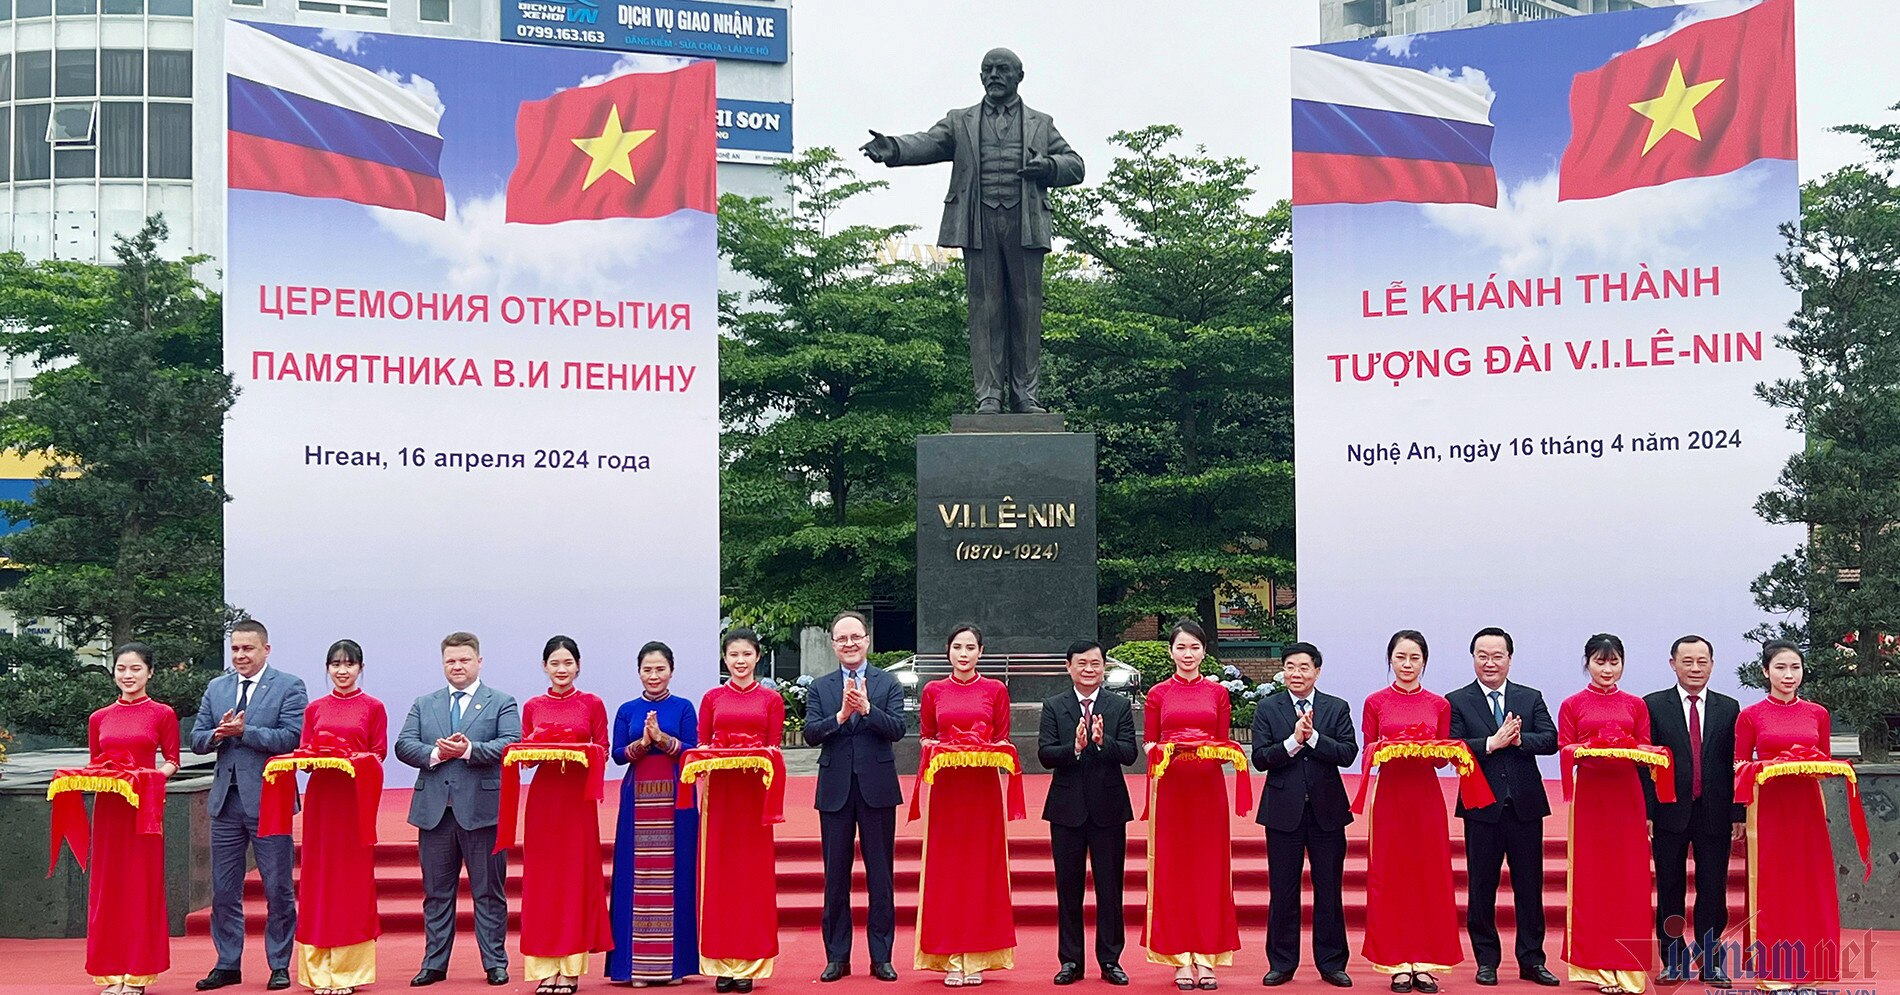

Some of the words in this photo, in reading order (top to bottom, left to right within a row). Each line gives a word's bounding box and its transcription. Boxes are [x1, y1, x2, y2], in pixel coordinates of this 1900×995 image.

[566, 7, 599, 24] VN
[618, 4, 651, 30] DỊCH
[654, 8, 674, 34] VỤ
[678, 10, 711, 33] GIAO
[713, 10, 753, 39] NHẬN
[756, 17, 775, 38] XE
[516, 25, 605, 43] 0799.163.163
[736, 110, 781, 131] SƠN
[259, 285, 489, 323] ЦЕРЕМОНИЯ
[500, 295, 691, 331] ОТКРЫТИЯ
[1362, 280, 1409, 318] LỄ
[1421, 273, 1562, 315] KHÁNH
[1575, 263, 1721, 304] THÀNH
[252, 351, 483, 387] ПАМЯТНИКА
[493, 359, 549, 389] В.И
[560, 361, 696, 393] ЛЕНИНУ
[1327, 346, 1472, 387] TƯỢNG
[1483, 336, 1552, 375] ĐÀI
[1564, 328, 1763, 371] V.I.LÊ-NIN
[305, 445, 388, 470] Нгеан,
[398, 447, 426, 467] 16
[434, 452, 525, 473] апреля
[533, 449, 590, 469] 2024
[598, 455, 651, 473] года
[1347, 443, 1401, 466] Nghệ
[1406, 441, 1442, 463] An,
[1449, 438, 1502, 463] ngày
[1509, 437, 1534, 457] 16
[1540, 435, 1604, 459] tháng
[1611, 433, 1624, 453] 4
[1631, 432, 1680, 452] năm
[1688, 429, 1742, 450] 2024
[956, 541, 1059, 561] (1870-1924)
